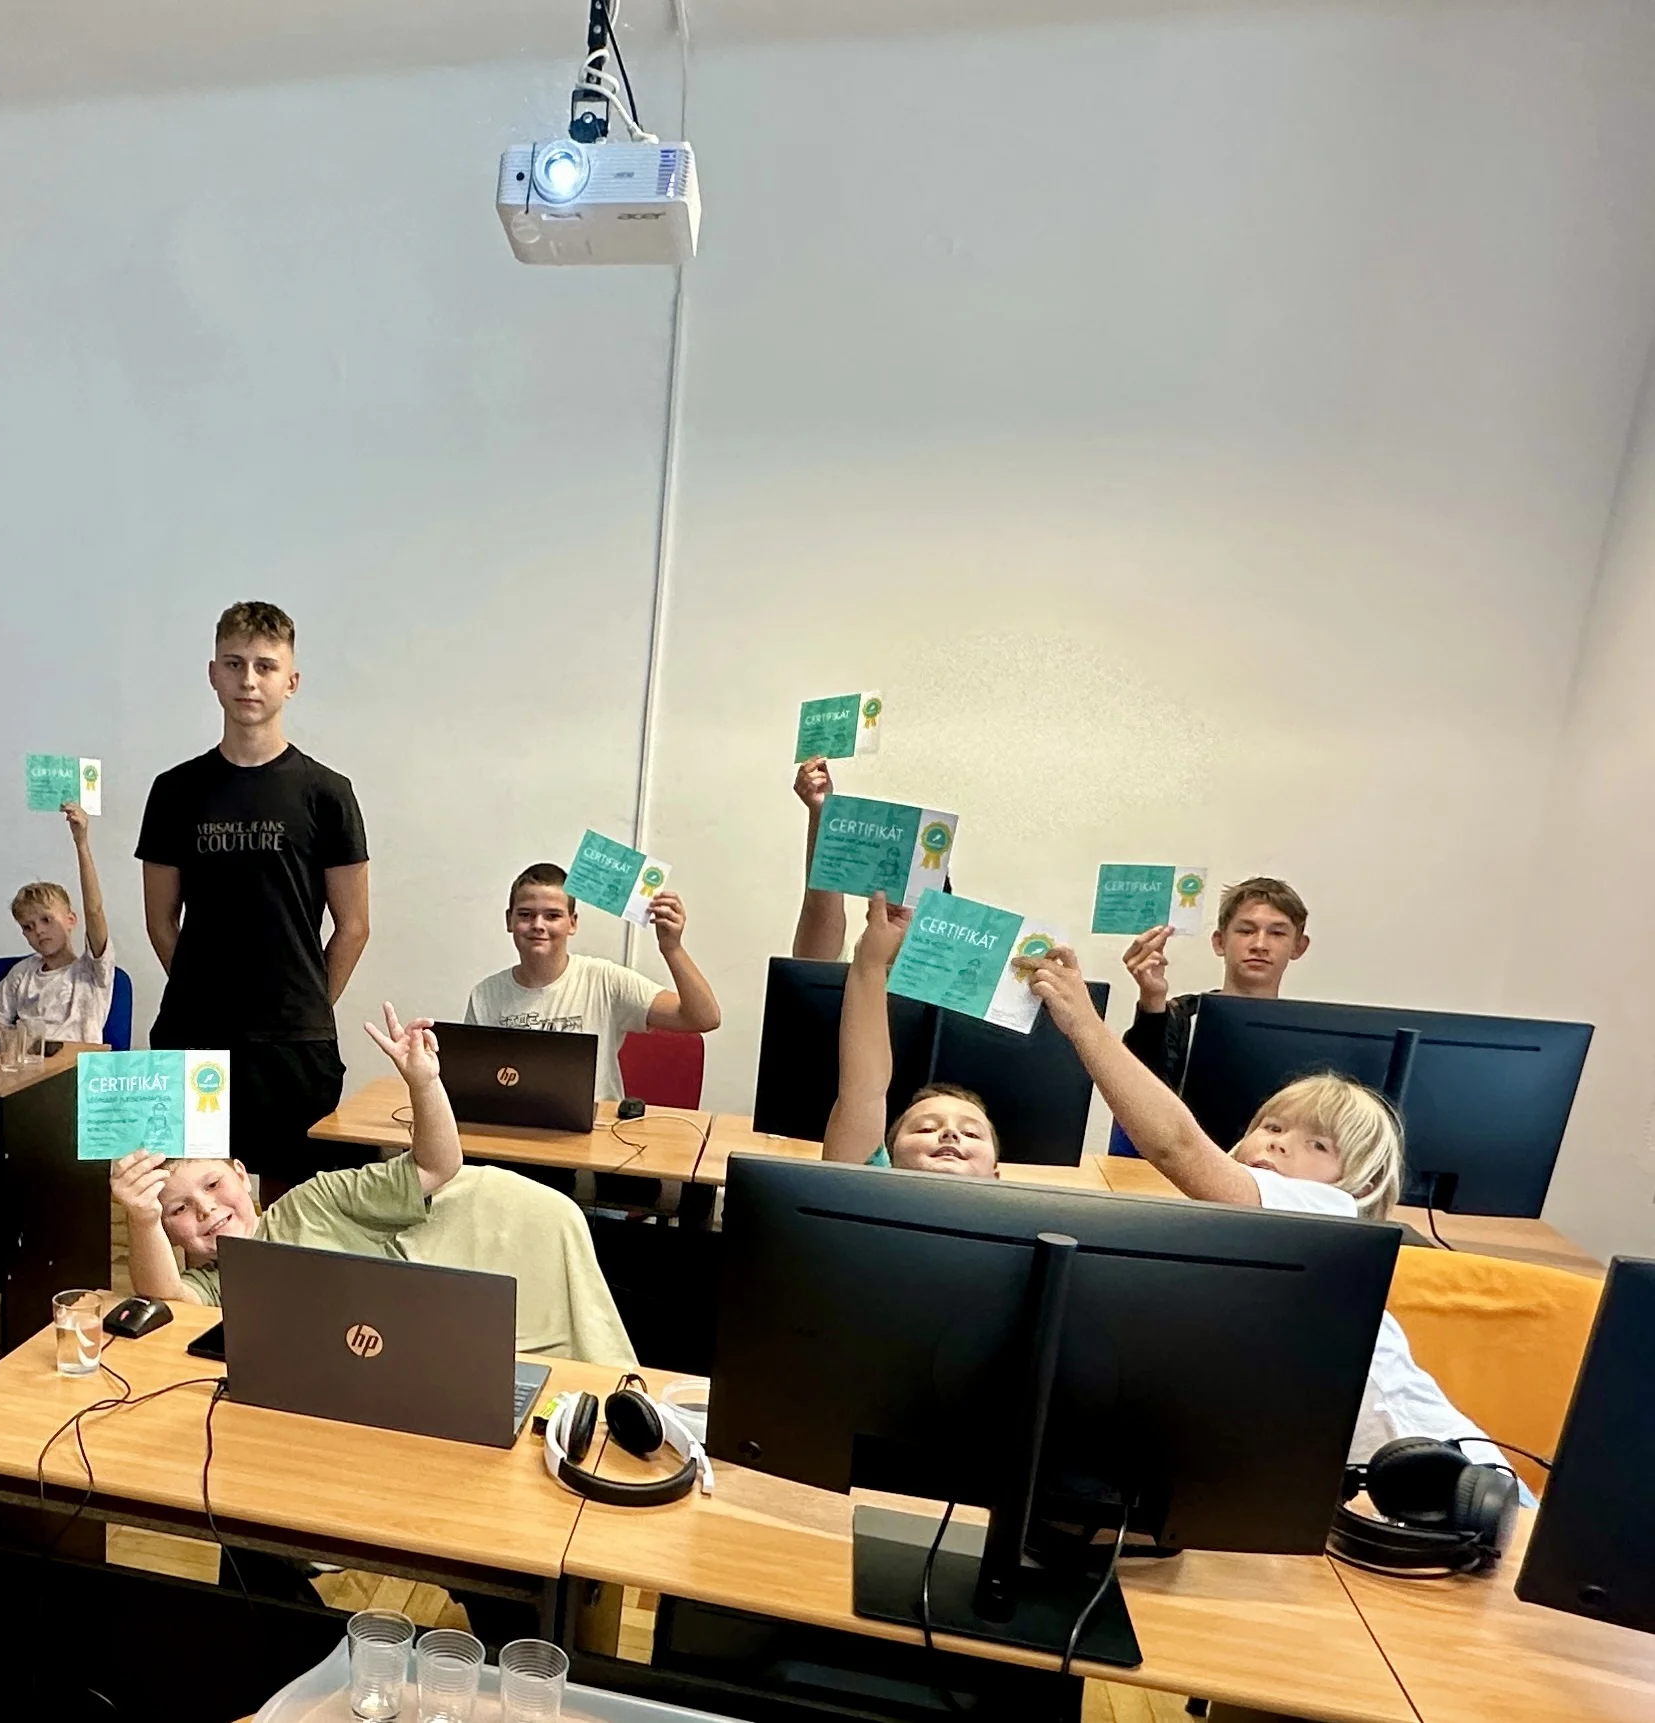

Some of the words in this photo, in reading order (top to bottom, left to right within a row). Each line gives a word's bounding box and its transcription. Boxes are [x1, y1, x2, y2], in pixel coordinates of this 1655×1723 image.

[246, 820, 285, 832] JEANS
[196, 832, 285, 853] COUTURE
[88, 1072, 170, 1093] CERTIFIKÁT
[499, 1067, 517, 1086] hp
[350, 1324, 381, 1358] hp
